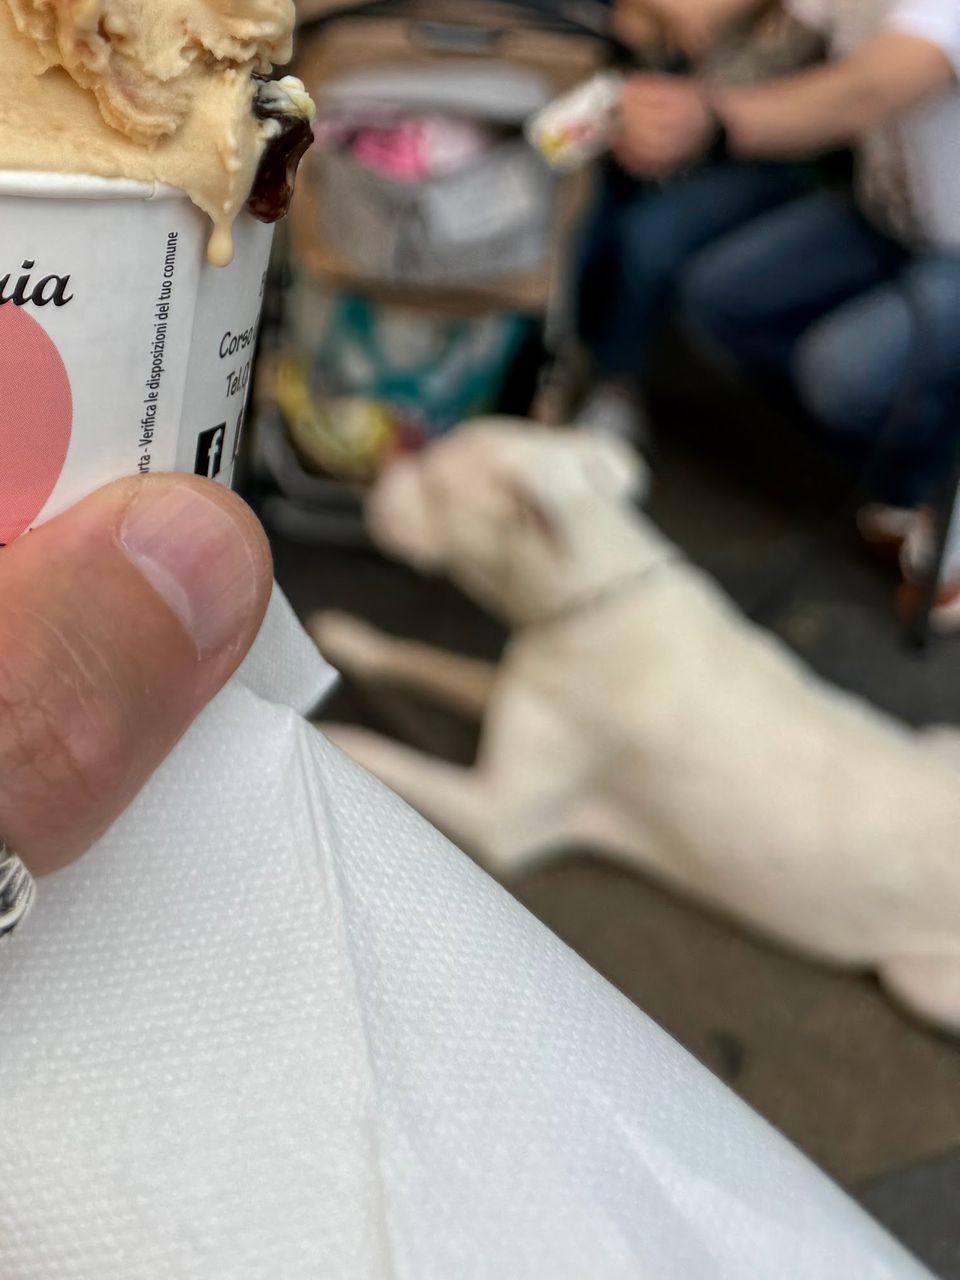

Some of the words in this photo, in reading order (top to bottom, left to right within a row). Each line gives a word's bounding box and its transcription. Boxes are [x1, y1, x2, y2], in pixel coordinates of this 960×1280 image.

[163, 231, 179, 278] comune
[157, 280, 173, 301] tuo
[154, 301, 170, 321] del
[145, 322, 168, 390] disposizioni
[219, 325, 253, 360] Corso
[143, 391, 159, 403] le
[138, 404, 157, 448] Verifica
